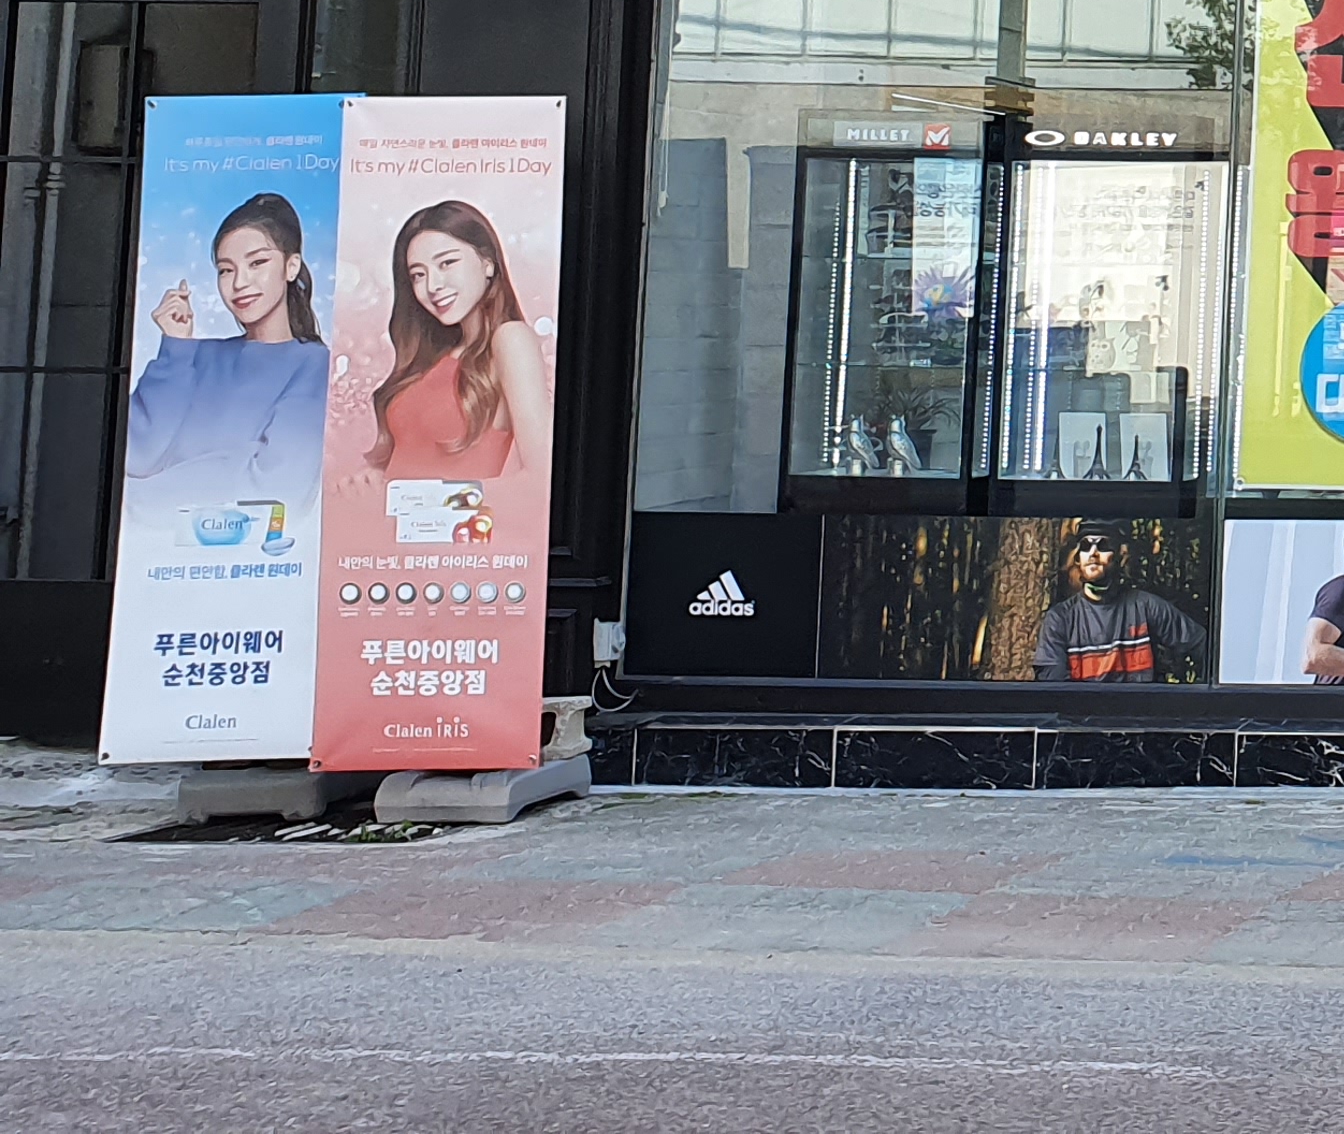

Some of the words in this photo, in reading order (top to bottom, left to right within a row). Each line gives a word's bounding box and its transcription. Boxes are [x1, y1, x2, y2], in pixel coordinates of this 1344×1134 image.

[847, 127, 909, 142] MILLET
[1074, 131, 1177, 147] OAKLEY
[193, 160, 219, 173] my
[377, 161, 405, 176] my
[201, 517, 244, 533] Clalen
[689, 598, 755, 618] adidas
[153, 629, 284, 656] 푸른아이웨어
[361, 639, 499, 665] 푸른아이웨어
[162, 661, 271, 687] 순천중앙점
[370, 669, 487, 697] 순천중앙점
[184, 713, 237, 731] Clalen
[383, 723, 432, 739] Clalen
